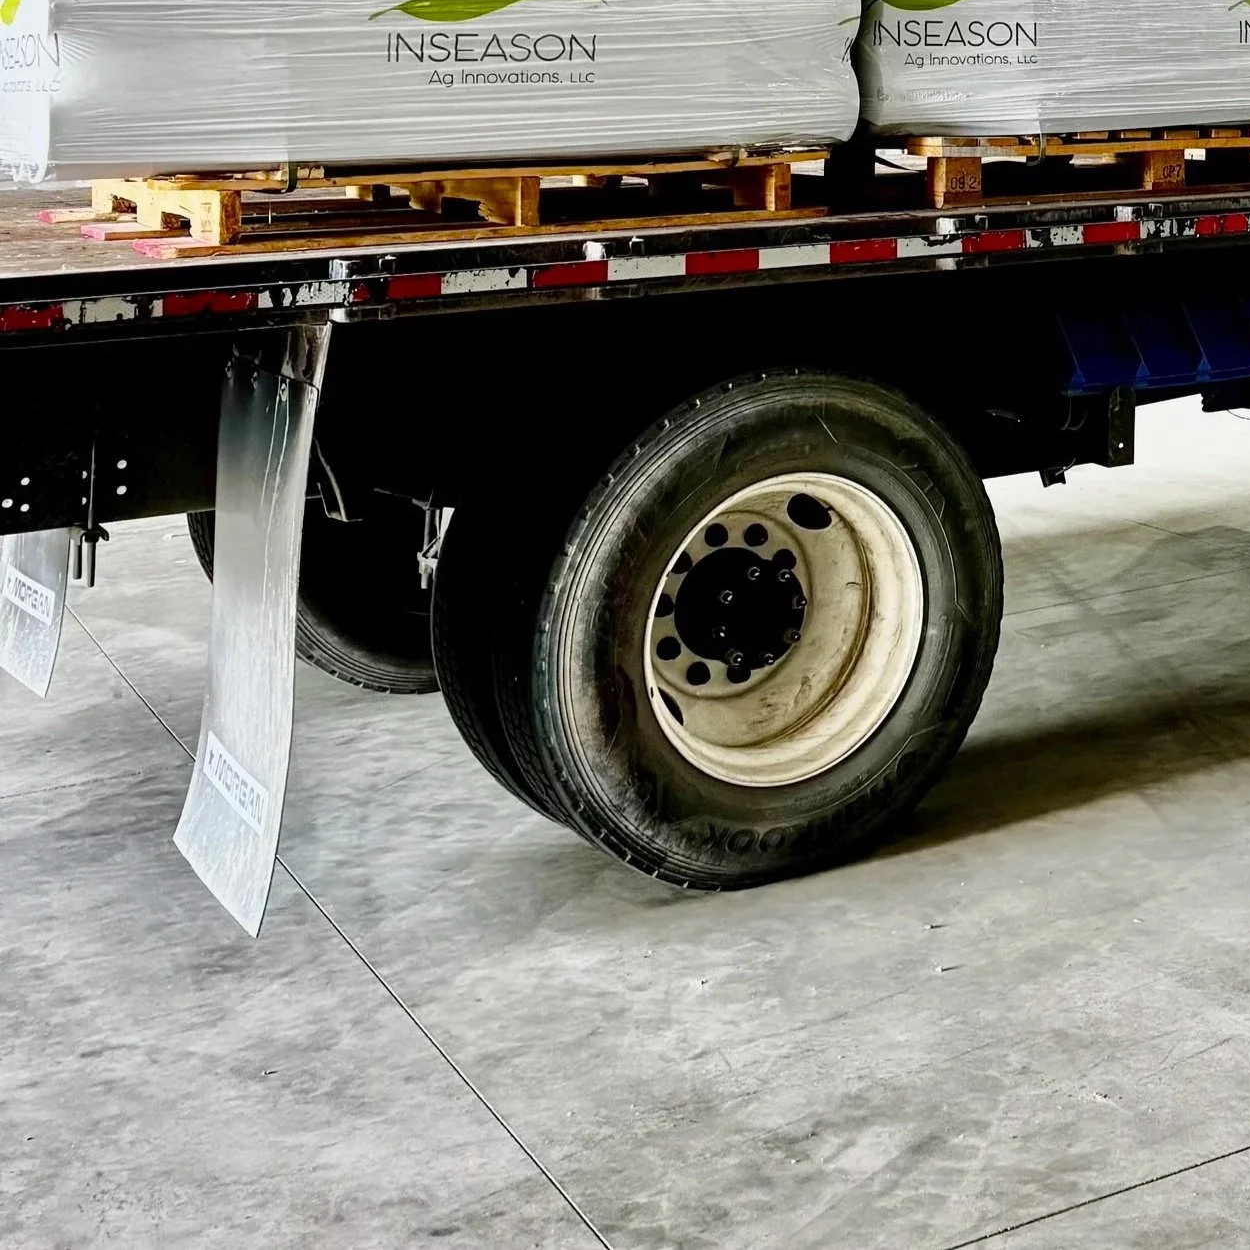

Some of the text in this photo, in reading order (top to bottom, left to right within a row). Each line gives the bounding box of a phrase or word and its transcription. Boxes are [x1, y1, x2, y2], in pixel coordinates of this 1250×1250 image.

[872, 20, 1038, 47] INSEASON
[387, 33, 597, 63] INSEASON
[904, 53, 924, 68] Ag
[1017, 54, 1039, 64] LLC
[428, 69, 454, 88] Ag
[570, 72, 595, 84] LLC
[14, 576, 50, 618] MORGAN
[214, 752, 265, 827] MORGAN
